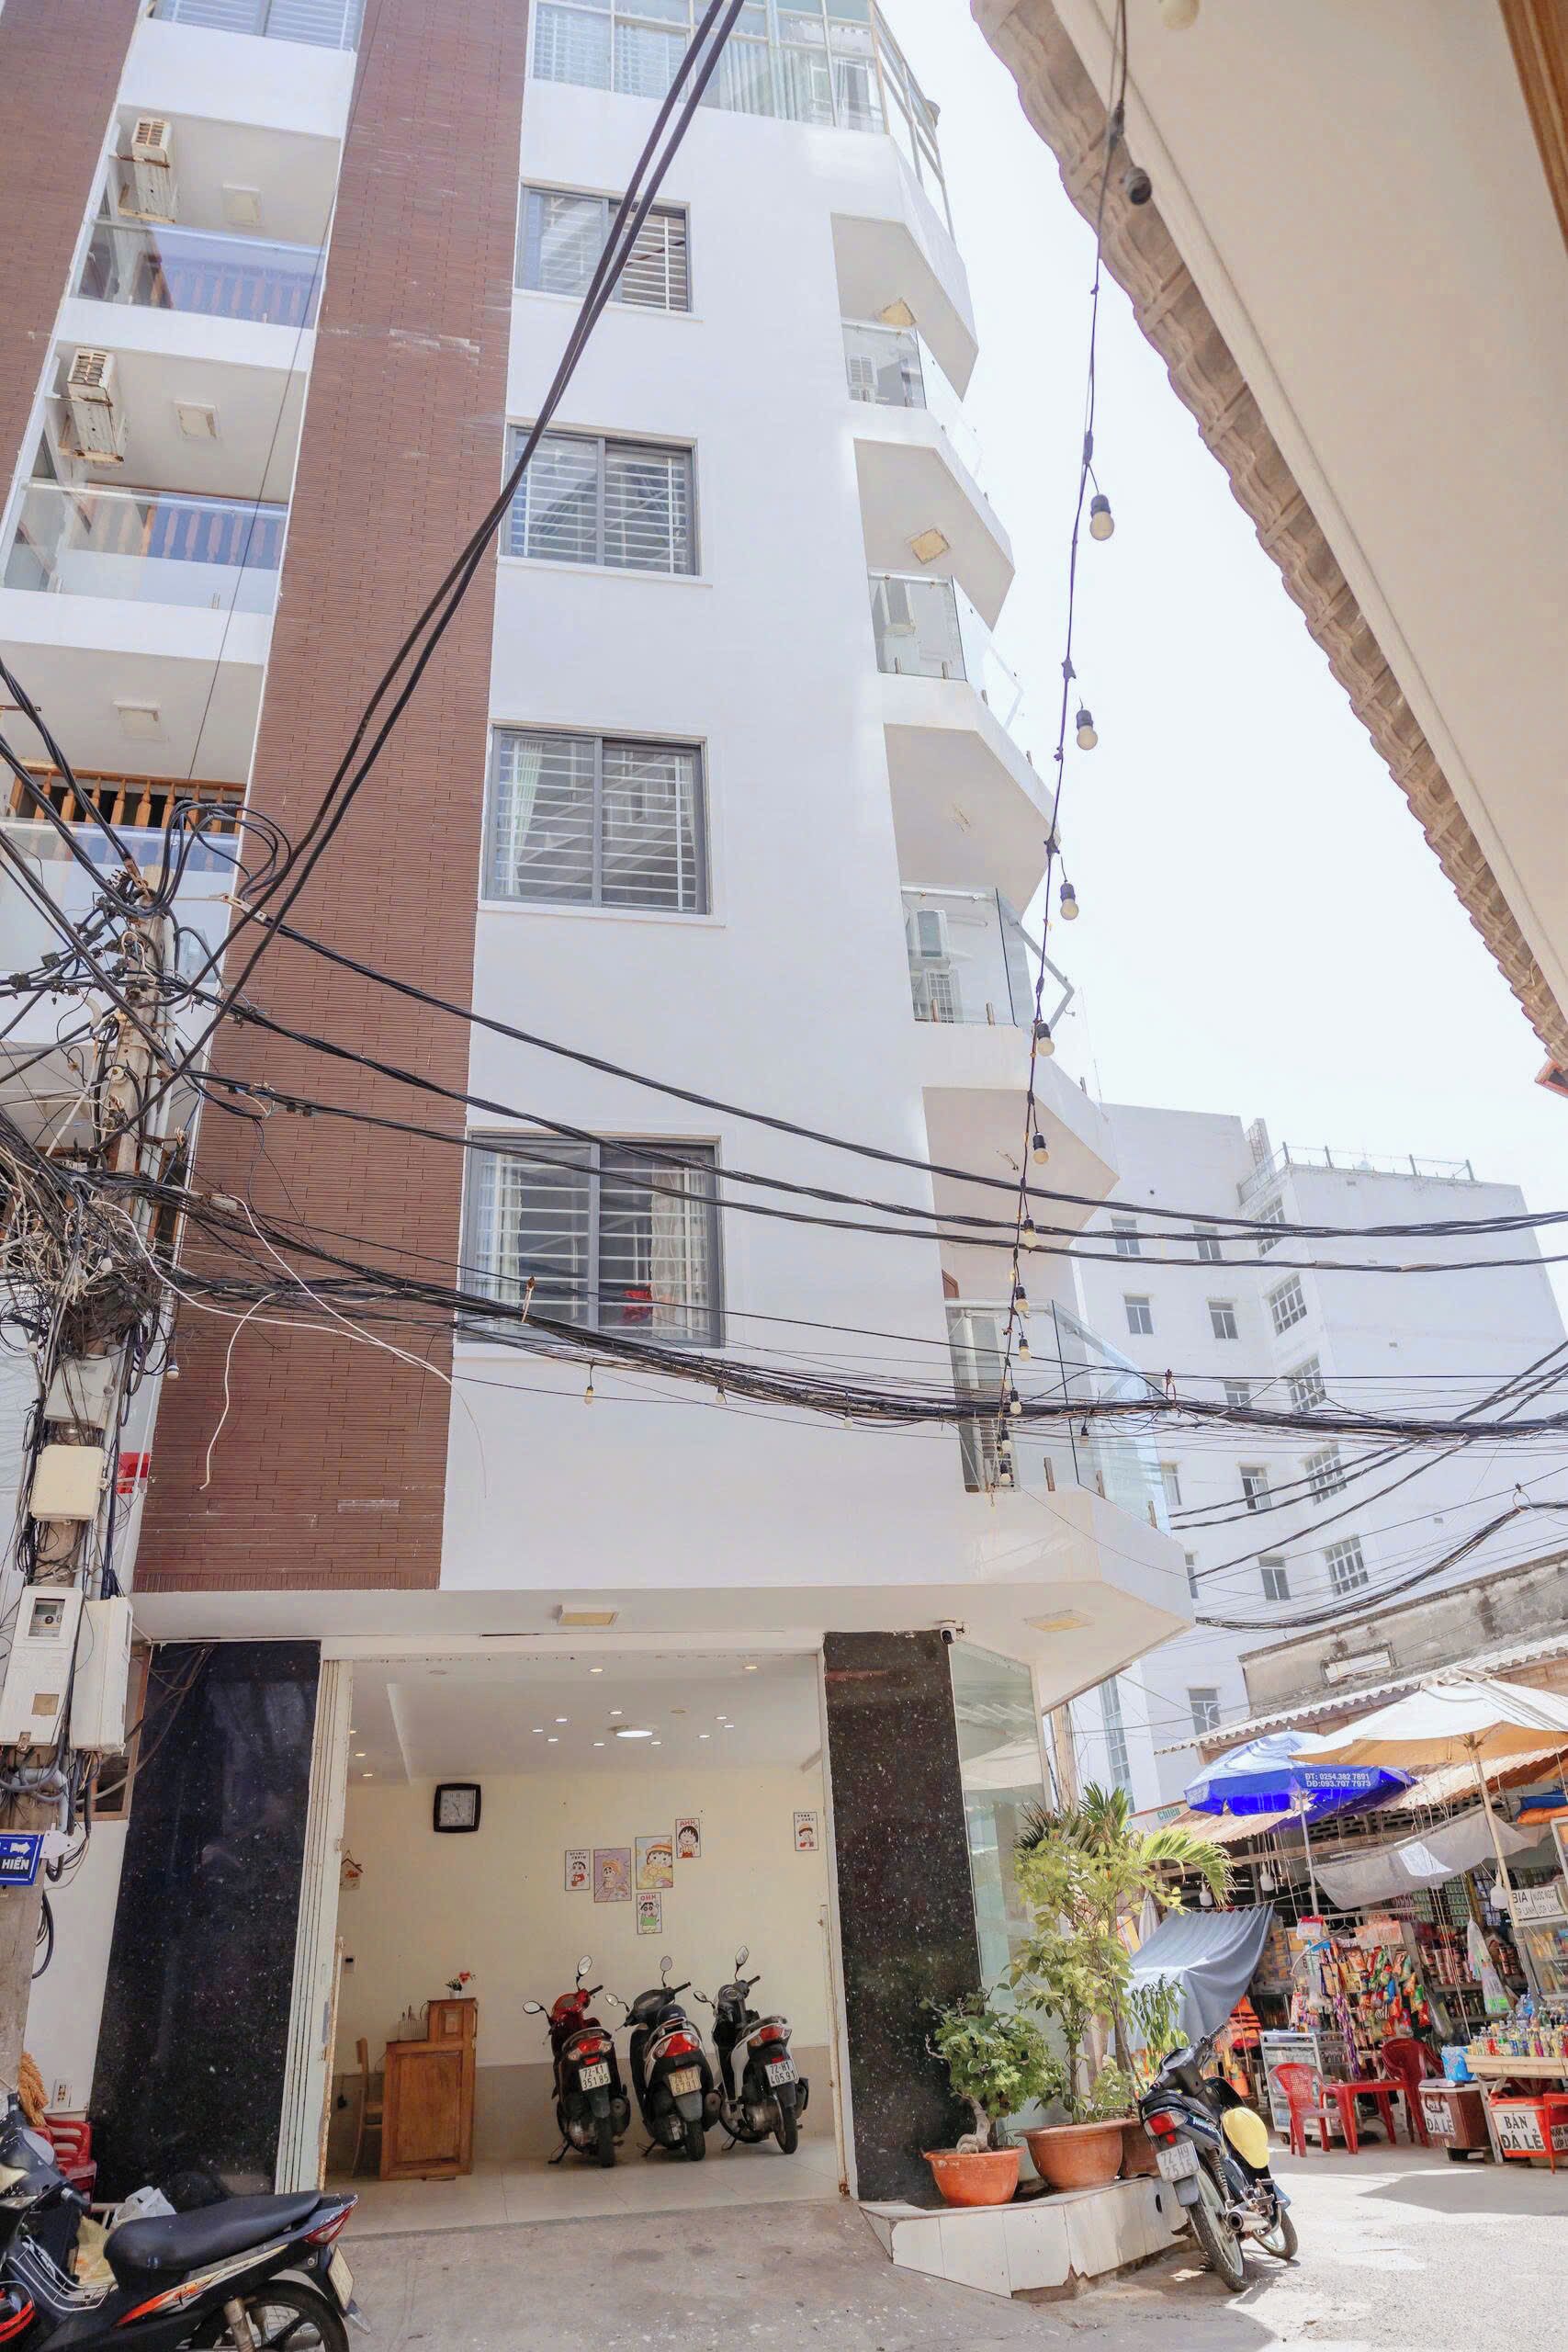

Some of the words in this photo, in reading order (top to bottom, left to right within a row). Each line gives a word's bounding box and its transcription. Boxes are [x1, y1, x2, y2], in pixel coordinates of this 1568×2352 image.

[582, 2074, 609, 2090] 35185
[1504, 2112, 1529, 2130] BÁN
[1523, 2128, 1545, 2150] LẺ
